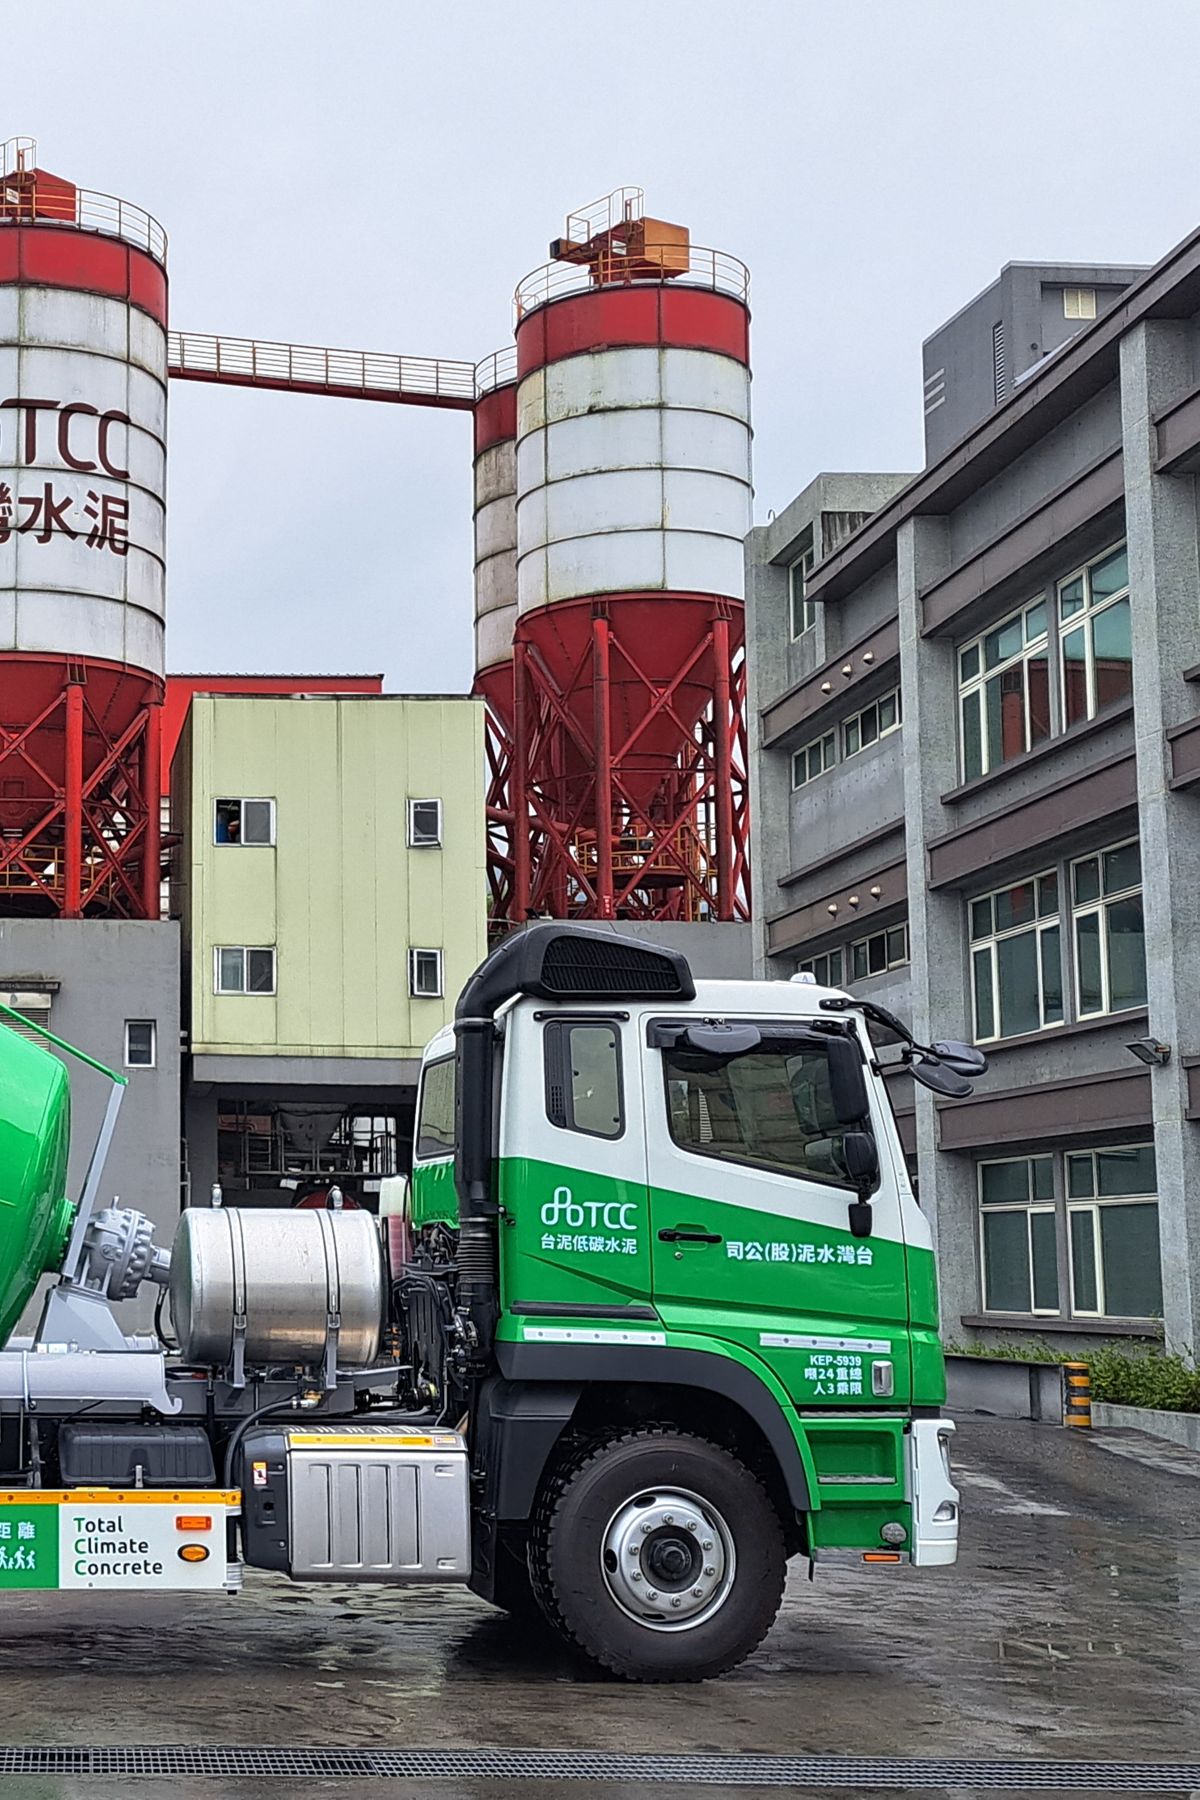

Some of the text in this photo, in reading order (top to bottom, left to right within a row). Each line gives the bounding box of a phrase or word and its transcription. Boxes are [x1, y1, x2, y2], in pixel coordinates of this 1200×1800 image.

[0, 398, 132, 480] TCC
[583, 1201, 639, 1230] TCC
[540, 1233, 638, 1255] 台泥低碳水泥
[809, 1354, 863, 1367] KEP-5939
[73, 1515, 124, 1533] Total
[73, 1537, 150, 1555] Climate
[73, 1558, 164, 1577] Concrete
